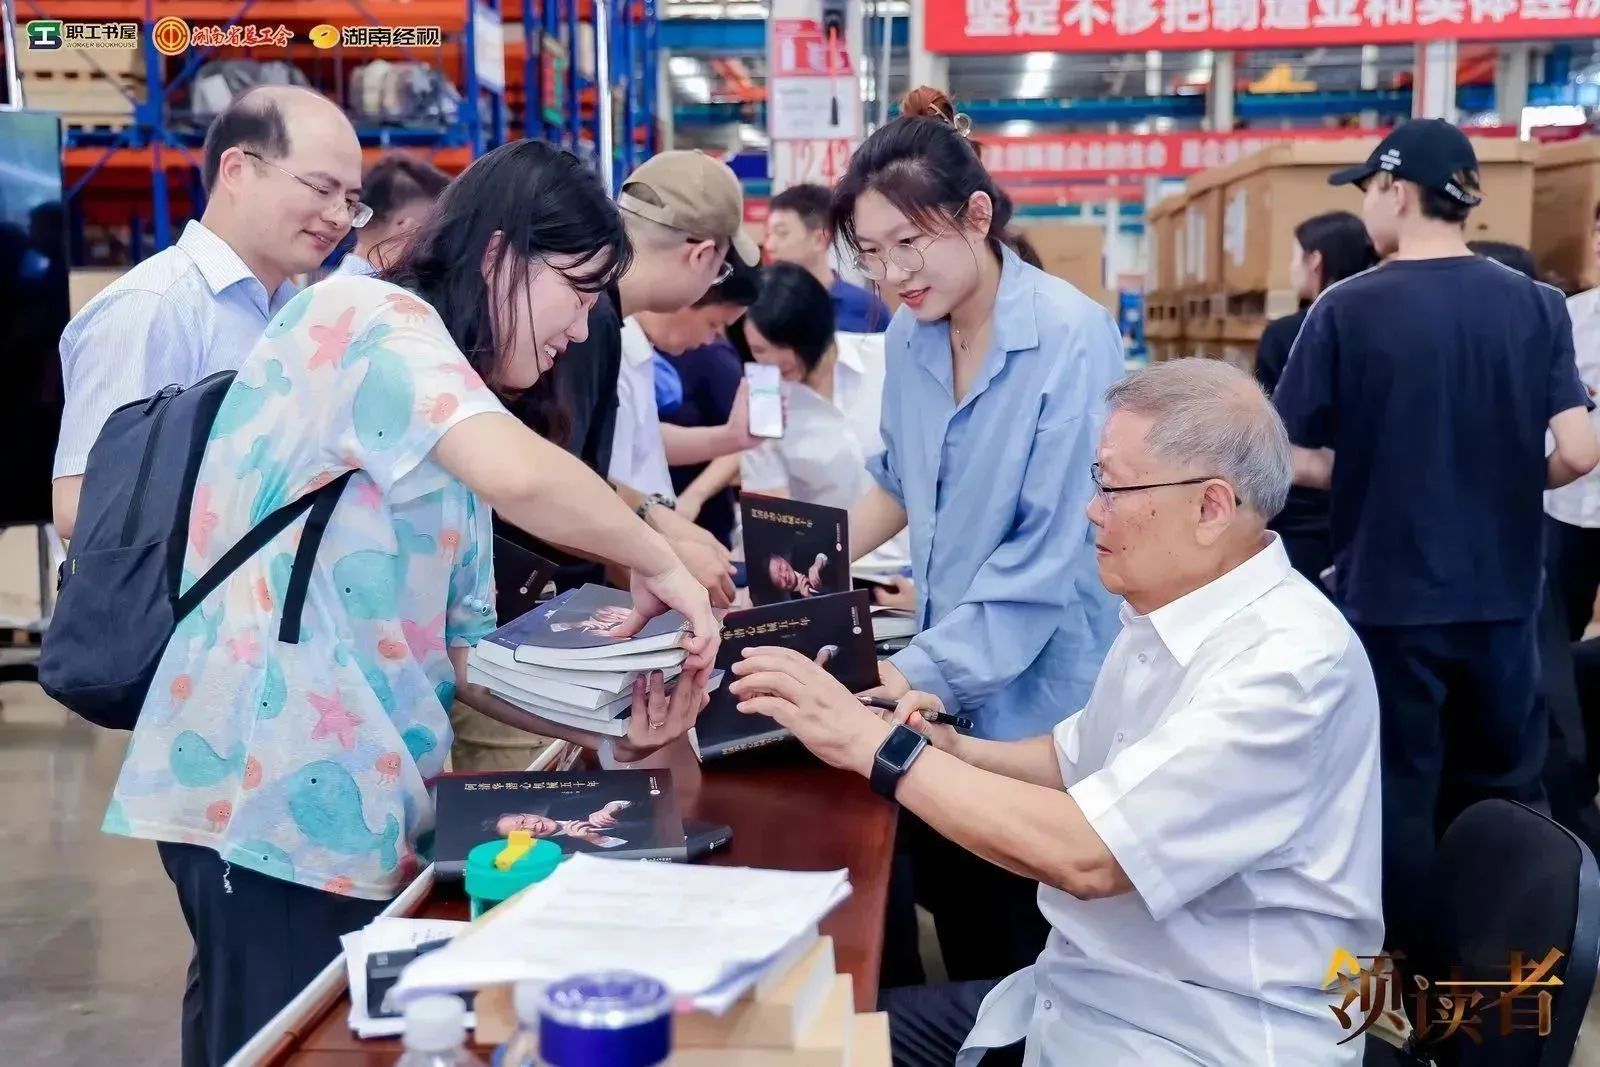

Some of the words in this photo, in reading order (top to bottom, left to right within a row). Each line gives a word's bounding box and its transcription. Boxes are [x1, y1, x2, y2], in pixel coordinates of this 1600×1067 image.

[720, 616, 811, 640] 华潜心机械五十年
